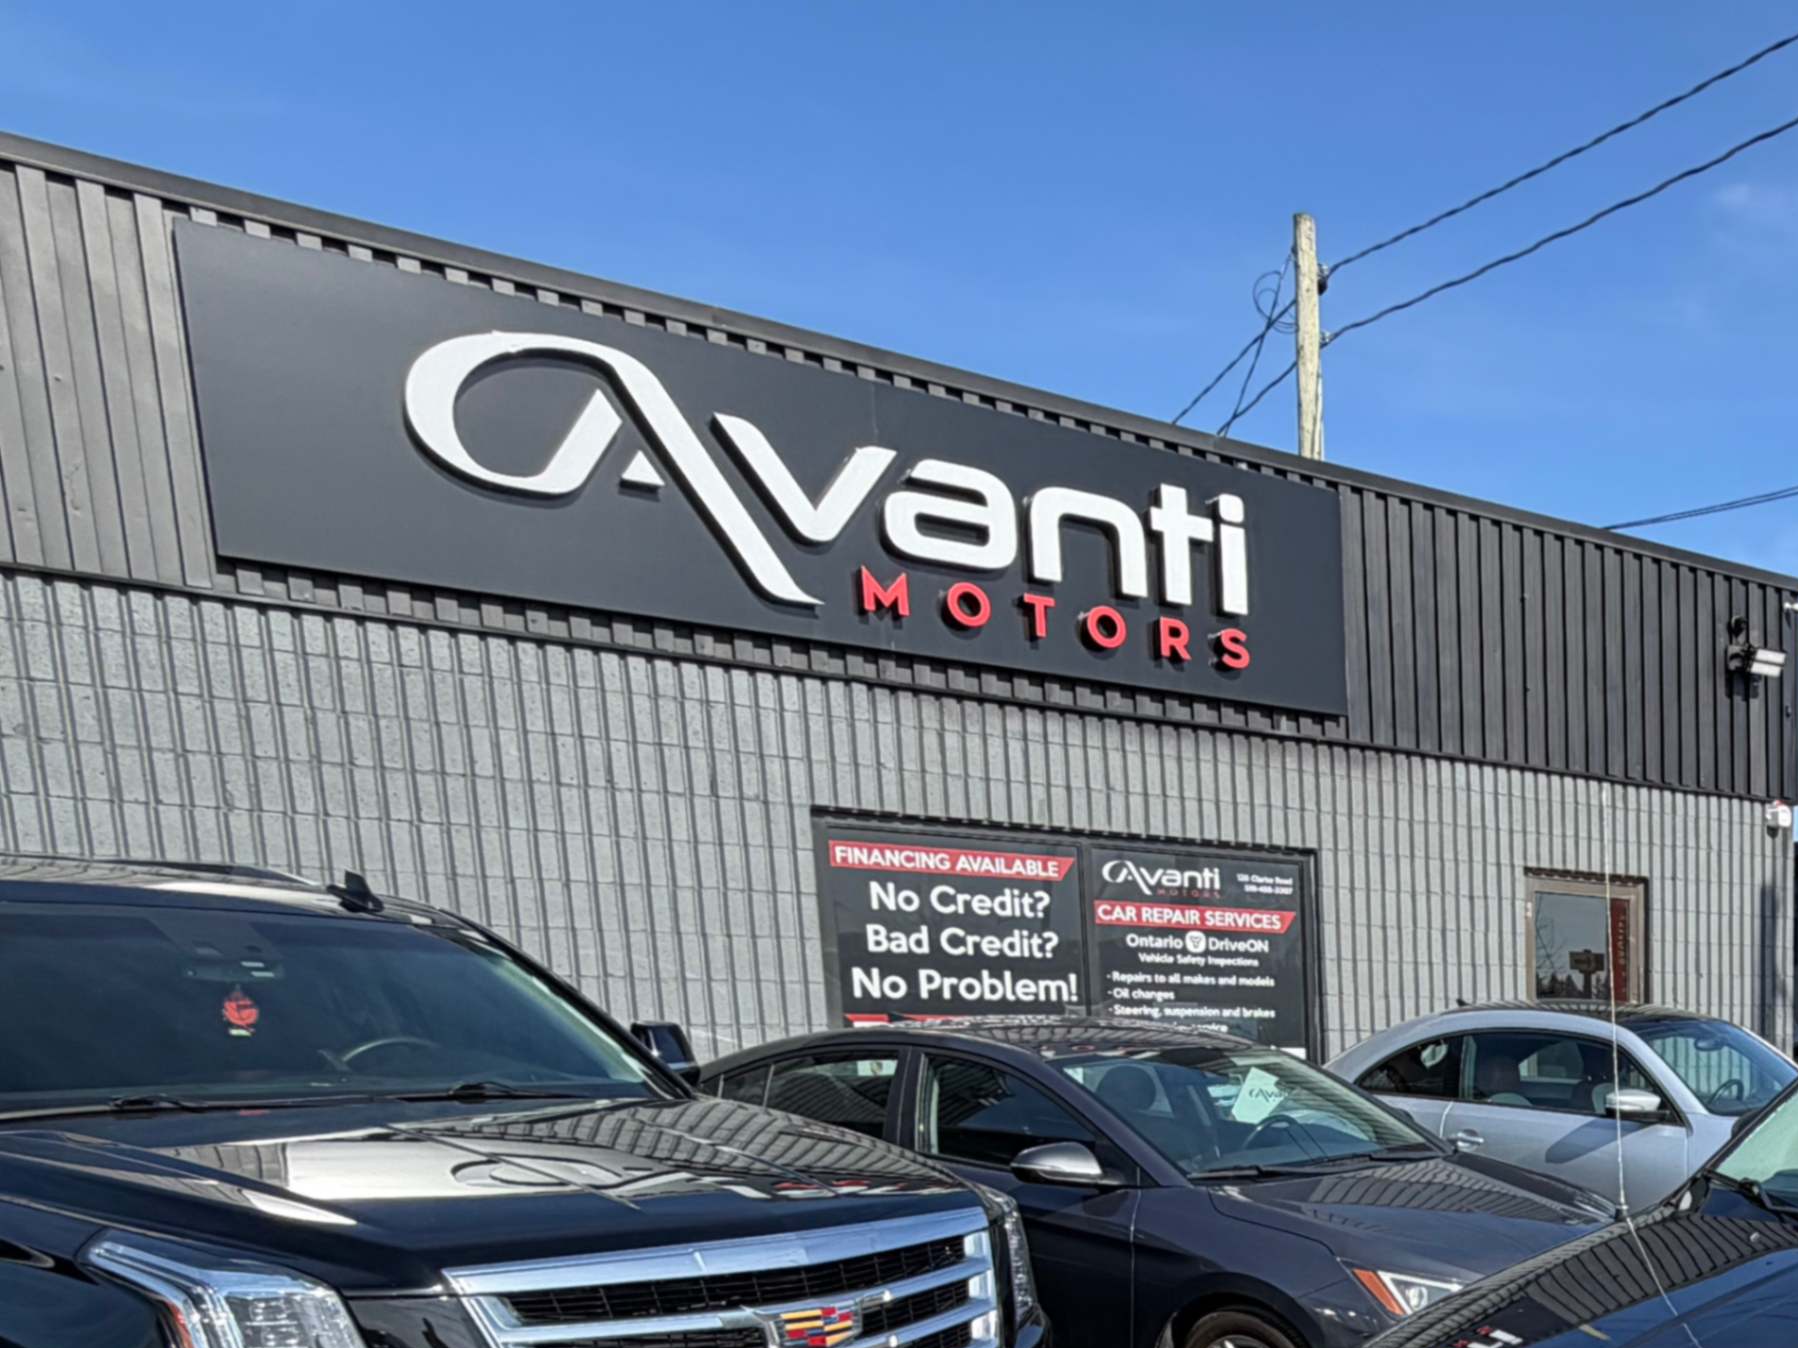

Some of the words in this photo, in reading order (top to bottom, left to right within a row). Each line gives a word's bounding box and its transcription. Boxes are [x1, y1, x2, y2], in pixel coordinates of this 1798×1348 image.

[405, 331, 1249, 616] Avanti
[860, 566, 1250, 669] MOTORS
[834, 846, 950, 870] FINANCING
[956, 857, 1059, 877] AVAILABLE
[1101, 860, 1221, 896] Avanti
[869, 881, 920, 912] No
[929, 885, 1050, 917] Credit?
[1097, 904, 1138, 922] CAR
[1141, 907, 1201, 925] REPAIR
[1204, 911, 1282, 929] SERVICES
[866, 924, 930, 954] Bad
[940, 927, 1059, 958] Credit?
[1126, 933, 1184, 949] Ontario
[1208, 936, 1269, 953] DriveON
[1138, 952, 1174, 963] Vehicle
[1176, 954, 1206, 967] Safety
[1207, 955, 1259, 968] Inspections
[851, 967, 908, 999] No
[918, 969, 1079, 1002] Problem!
[1131, 988, 1175, 1003] changes
[1154, 974, 1167, 983] to
[1168, 973, 1181, 984] all
[1183, 974, 1216, 985] makes
[1218, 975, 1237, 986] and
[1238, 976, 1275, 987] models
[1163, 1006, 1220, 1019] suspension
[1222, 1006, 1241, 1017] and
[1242, 1006, 1276, 1018] brakes
